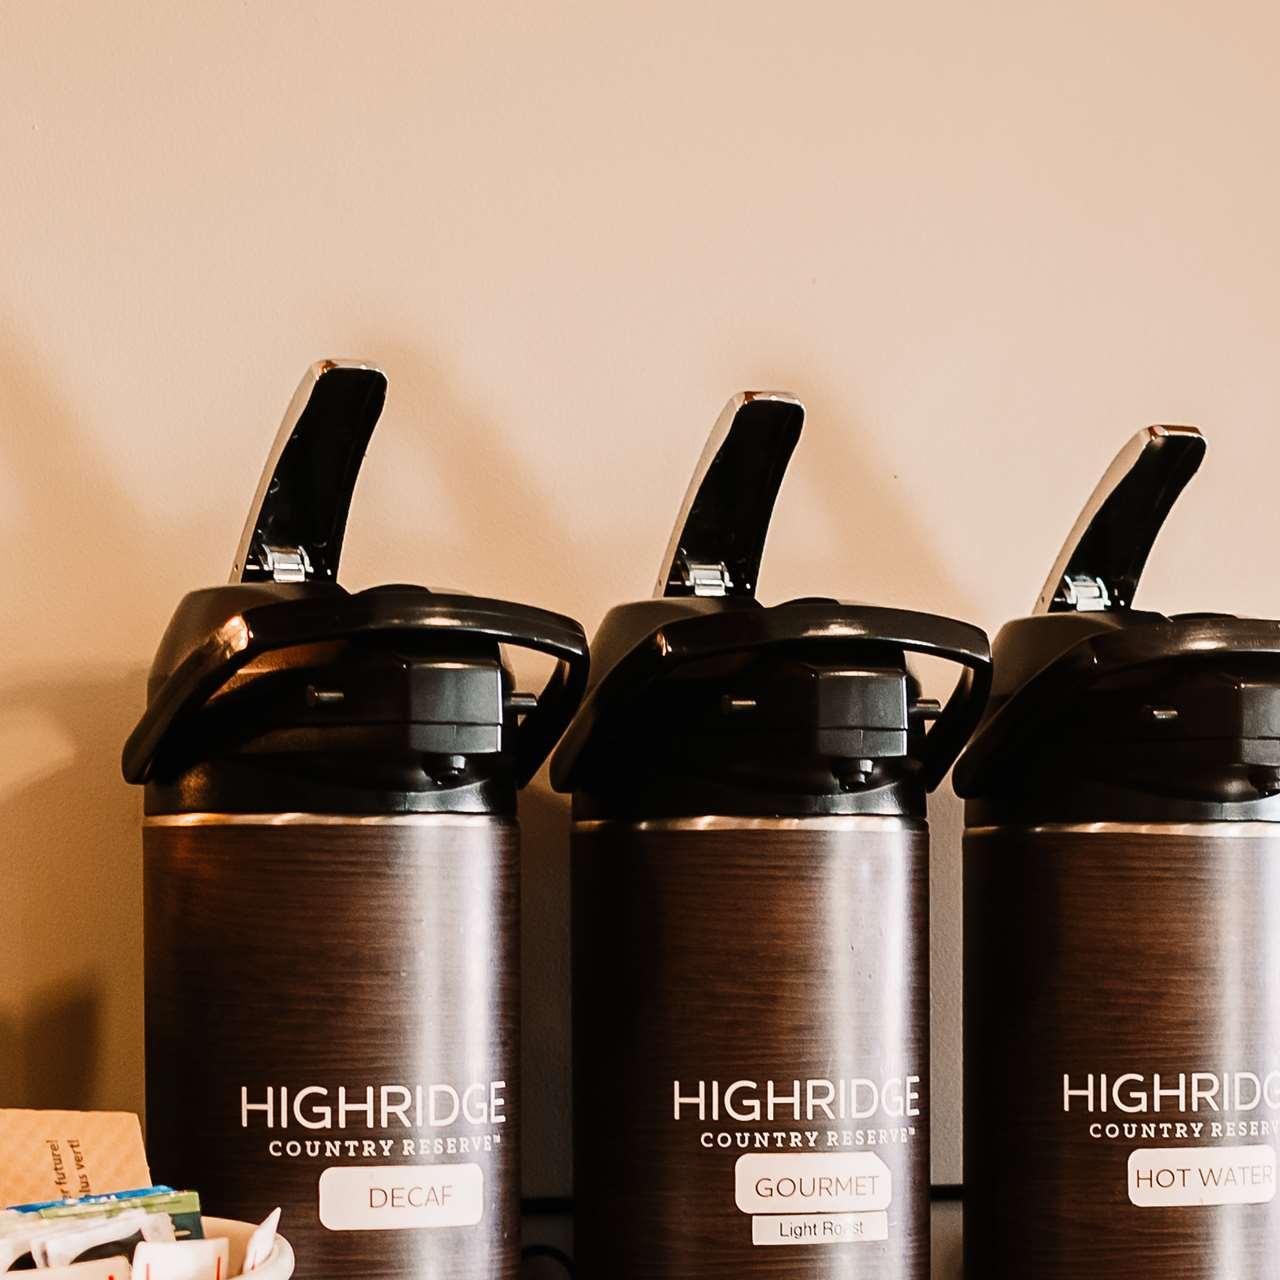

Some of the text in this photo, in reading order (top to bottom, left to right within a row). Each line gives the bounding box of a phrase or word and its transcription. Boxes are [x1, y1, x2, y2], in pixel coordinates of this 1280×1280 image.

[241, 1081, 506, 1129] HIGHRIDGE
[673, 1075, 920, 1121] HIGHRIDGE
[700, 1131, 819, 1148] COUNTRY
[1089, 1122, 1203, 1138] COUNTRY
[67, 1139, 85, 1170] vert!
[269, 1140, 394, 1157] COUNTRY
[755, 1175, 880, 1198] GOURMET
[1136, 1164, 1272, 1189] HOT WATER
[369, 1185, 453, 1209] DECAF
[779, 1221, 817, 1239] Light
